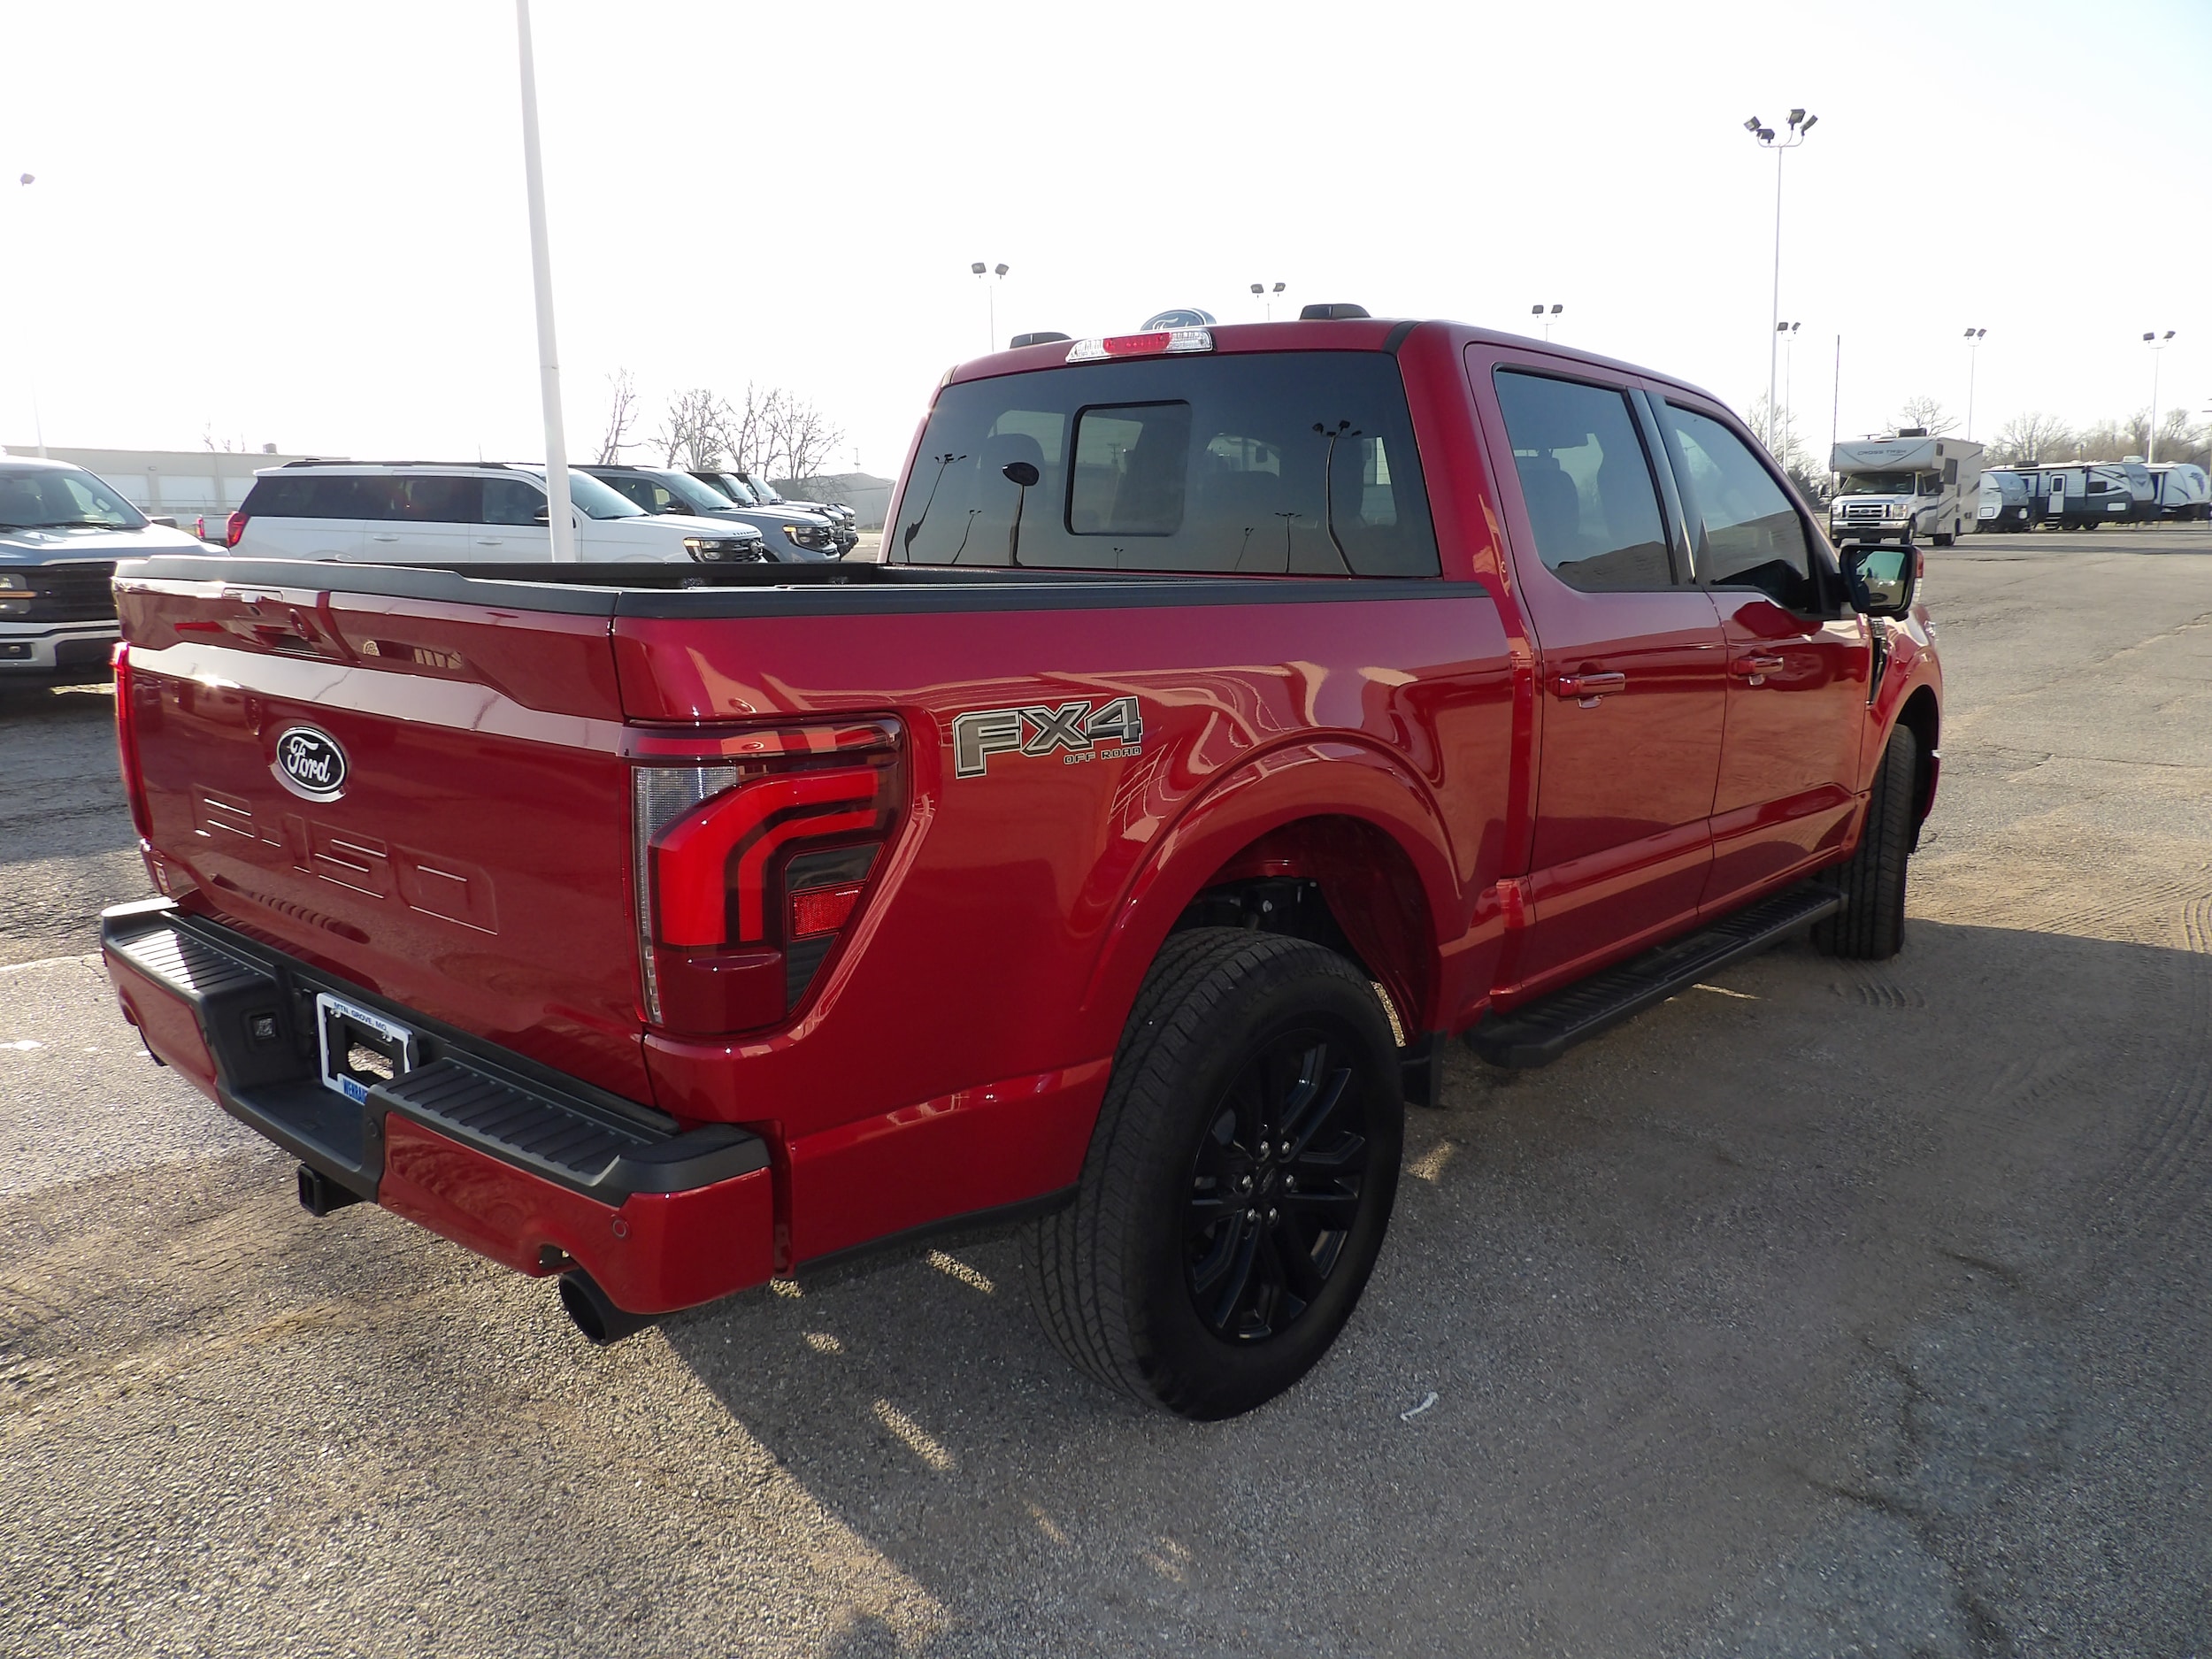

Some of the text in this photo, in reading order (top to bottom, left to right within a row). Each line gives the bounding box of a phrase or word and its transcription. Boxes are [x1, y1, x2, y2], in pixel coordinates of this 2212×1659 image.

[287, 736, 331, 783] Ford
[952, 695, 1143, 780] FX4
[1064, 746, 1142, 765] OFF ROAD
[192, 782, 498, 936] F-150
